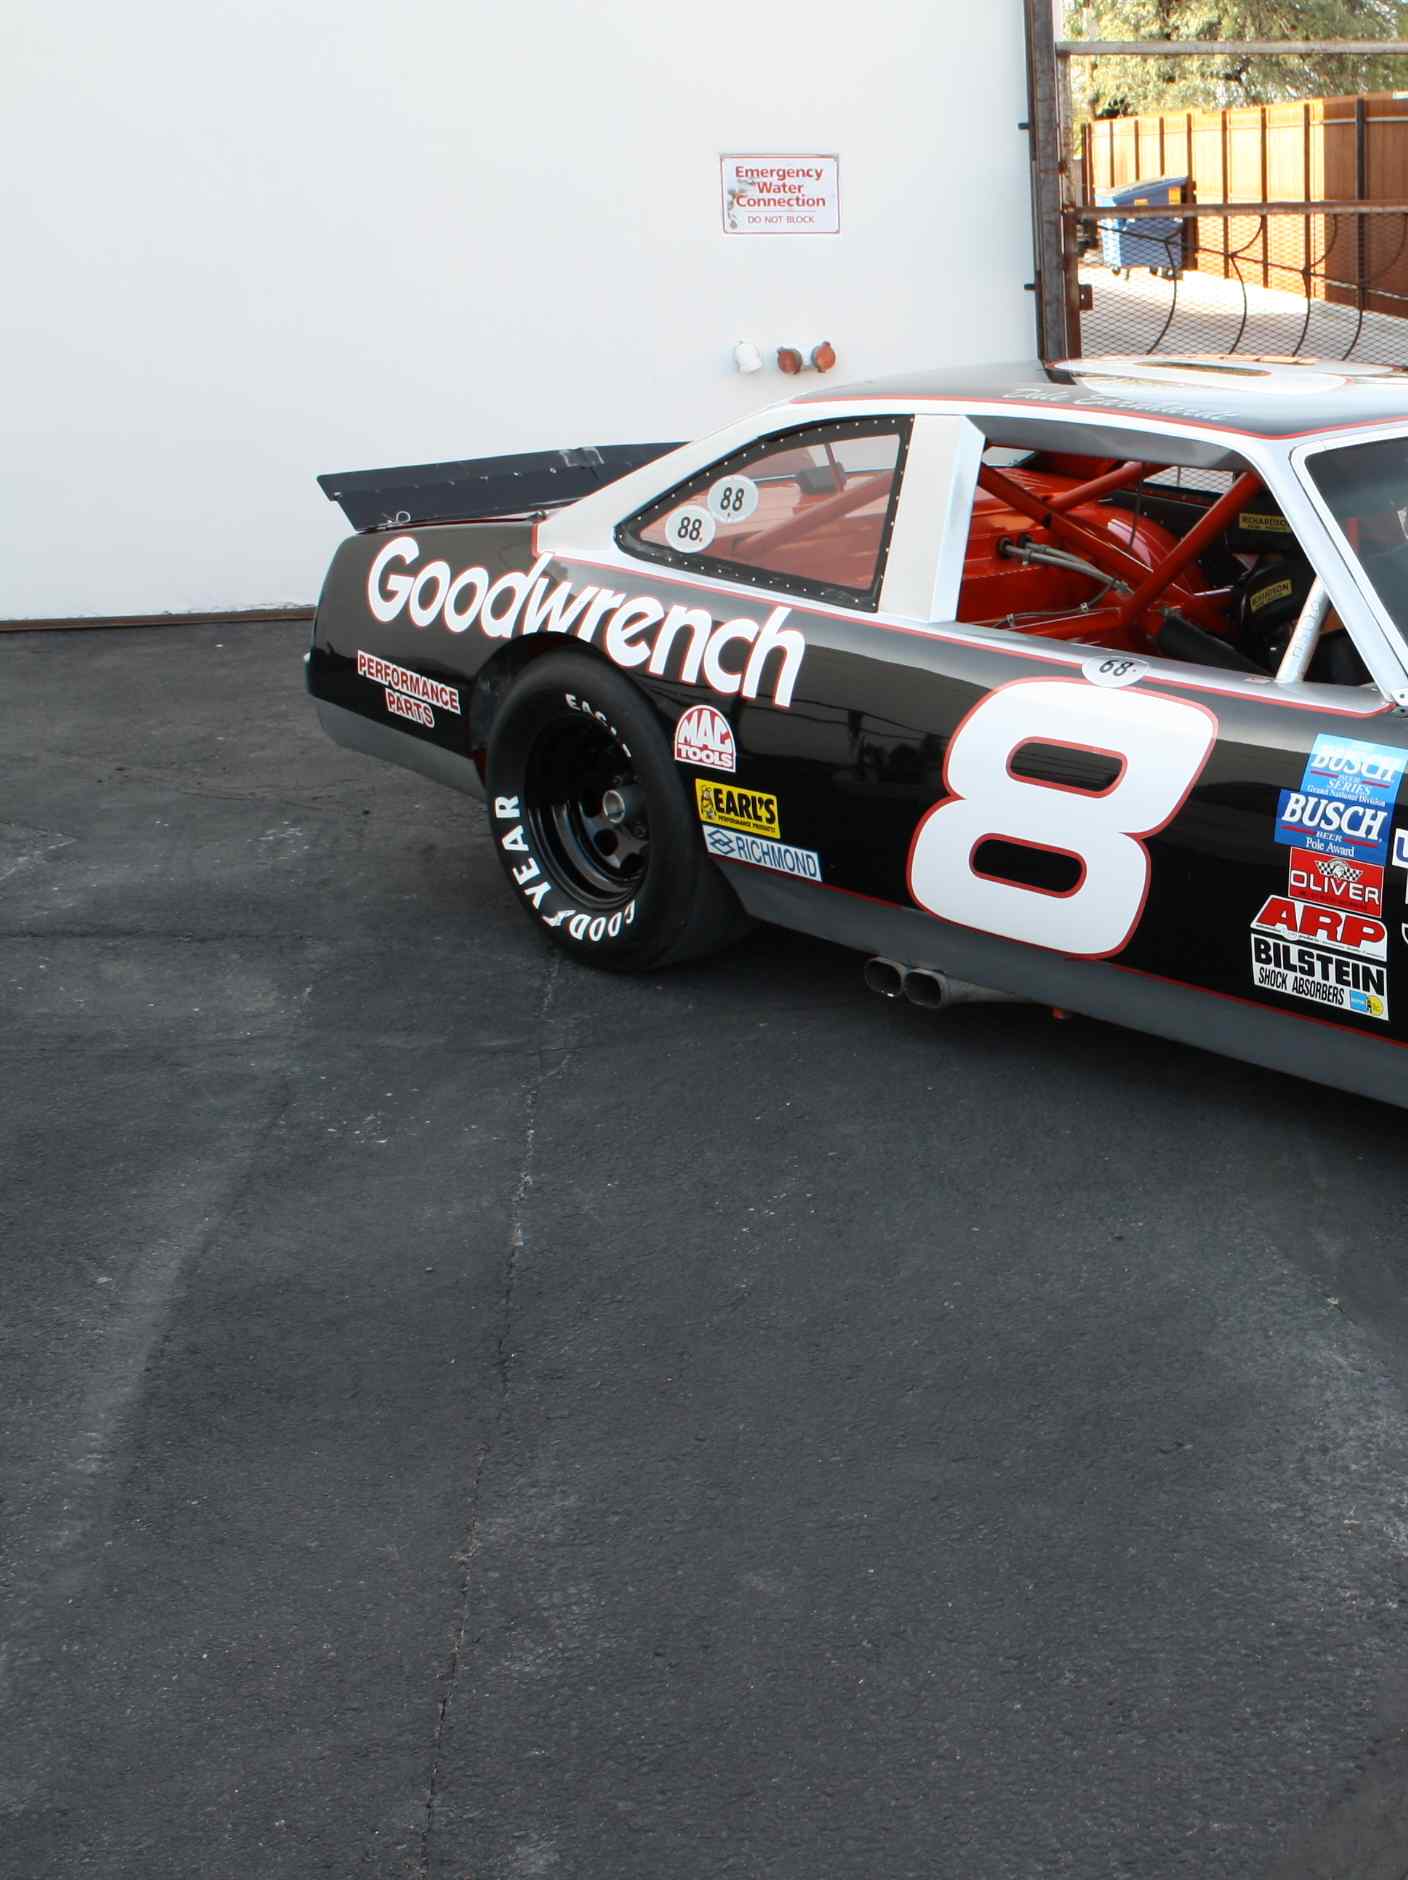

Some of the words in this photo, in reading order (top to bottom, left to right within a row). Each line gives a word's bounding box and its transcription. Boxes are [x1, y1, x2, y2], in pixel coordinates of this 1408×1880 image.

[735, 166, 823, 181] Emergency
[757, 181, 805, 194] Water
[735, 194, 826, 208] Connection
[747, 215, 762, 225] DO
[764, 215, 783, 225] NOT
[786, 215, 815, 225] BLOCK
[720, 486, 745, 512] 88
[677, 516, 703, 541] 88
[367, 535, 807, 708] Goodwrench
[358, 650, 461, 714] PERFORMANCE
[385, 688, 435, 728] PARTS
[678, 709, 732, 753] MAC
[678, 744, 733, 768] TOOLS
[1327, 779, 1371, 796] SERIES
[713, 788, 776, 825] EARL'S
[905, 675, 1219, 961] 8
[1281, 792, 1388, 841] BUSCH
[1305, 837, 1325, 850] Pole
[1326, 841, 1355, 858] Award
[1315, 830, 1344, 842] BEER
[735, 835, 818, 878] RICHMOND
[1290, 870, 1380, 905] OLIVER
[1255, 897, 1386, 948] ARP
[1253, 937, 1385, 997] BILSTEIN
[1258, 966, 1288, 991] SHOCK
[1292, 977, 1345, 1006] ABSORBERS
